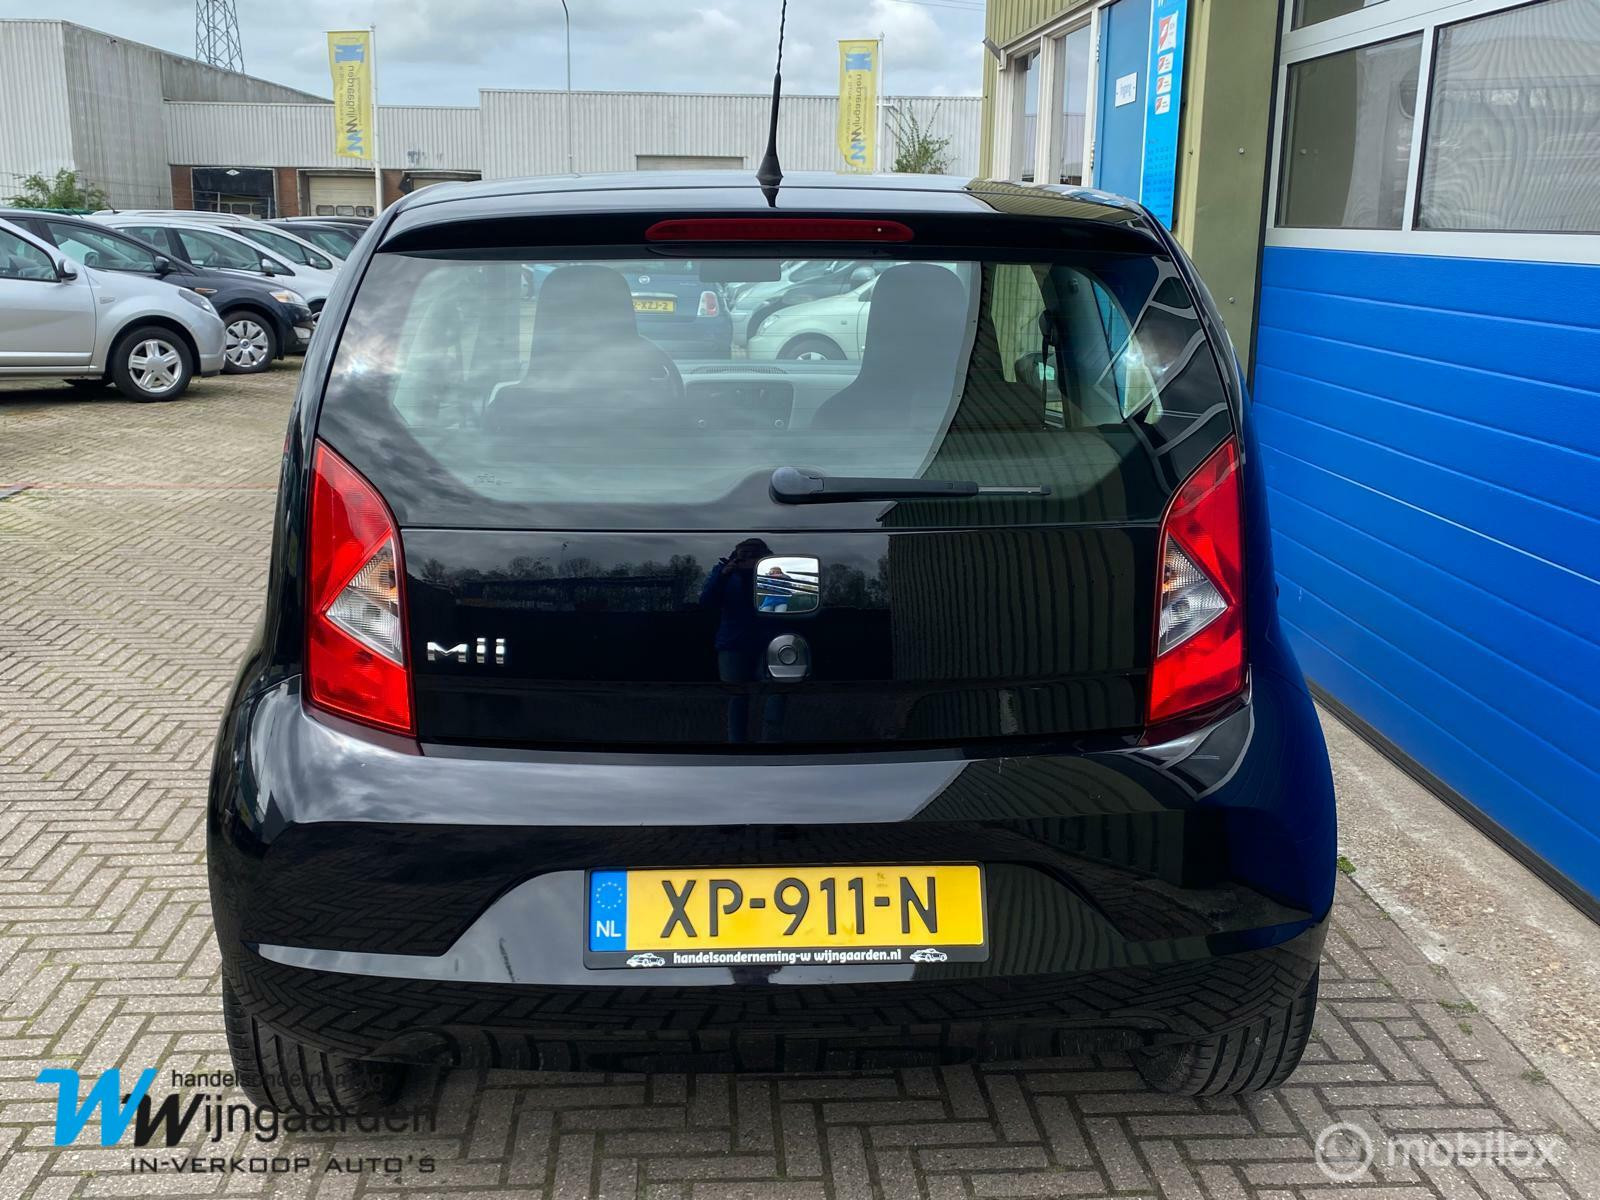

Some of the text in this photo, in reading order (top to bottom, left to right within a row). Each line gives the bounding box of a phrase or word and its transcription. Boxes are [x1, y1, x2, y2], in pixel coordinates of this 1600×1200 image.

[427, 637, 506, 664] Mii
[596, 920, 622, 938] NL
[660, 876, 938, 939] XP-911-N
[673, 949, 902, 964] handelsonderneming-w wijngaarden.nl
